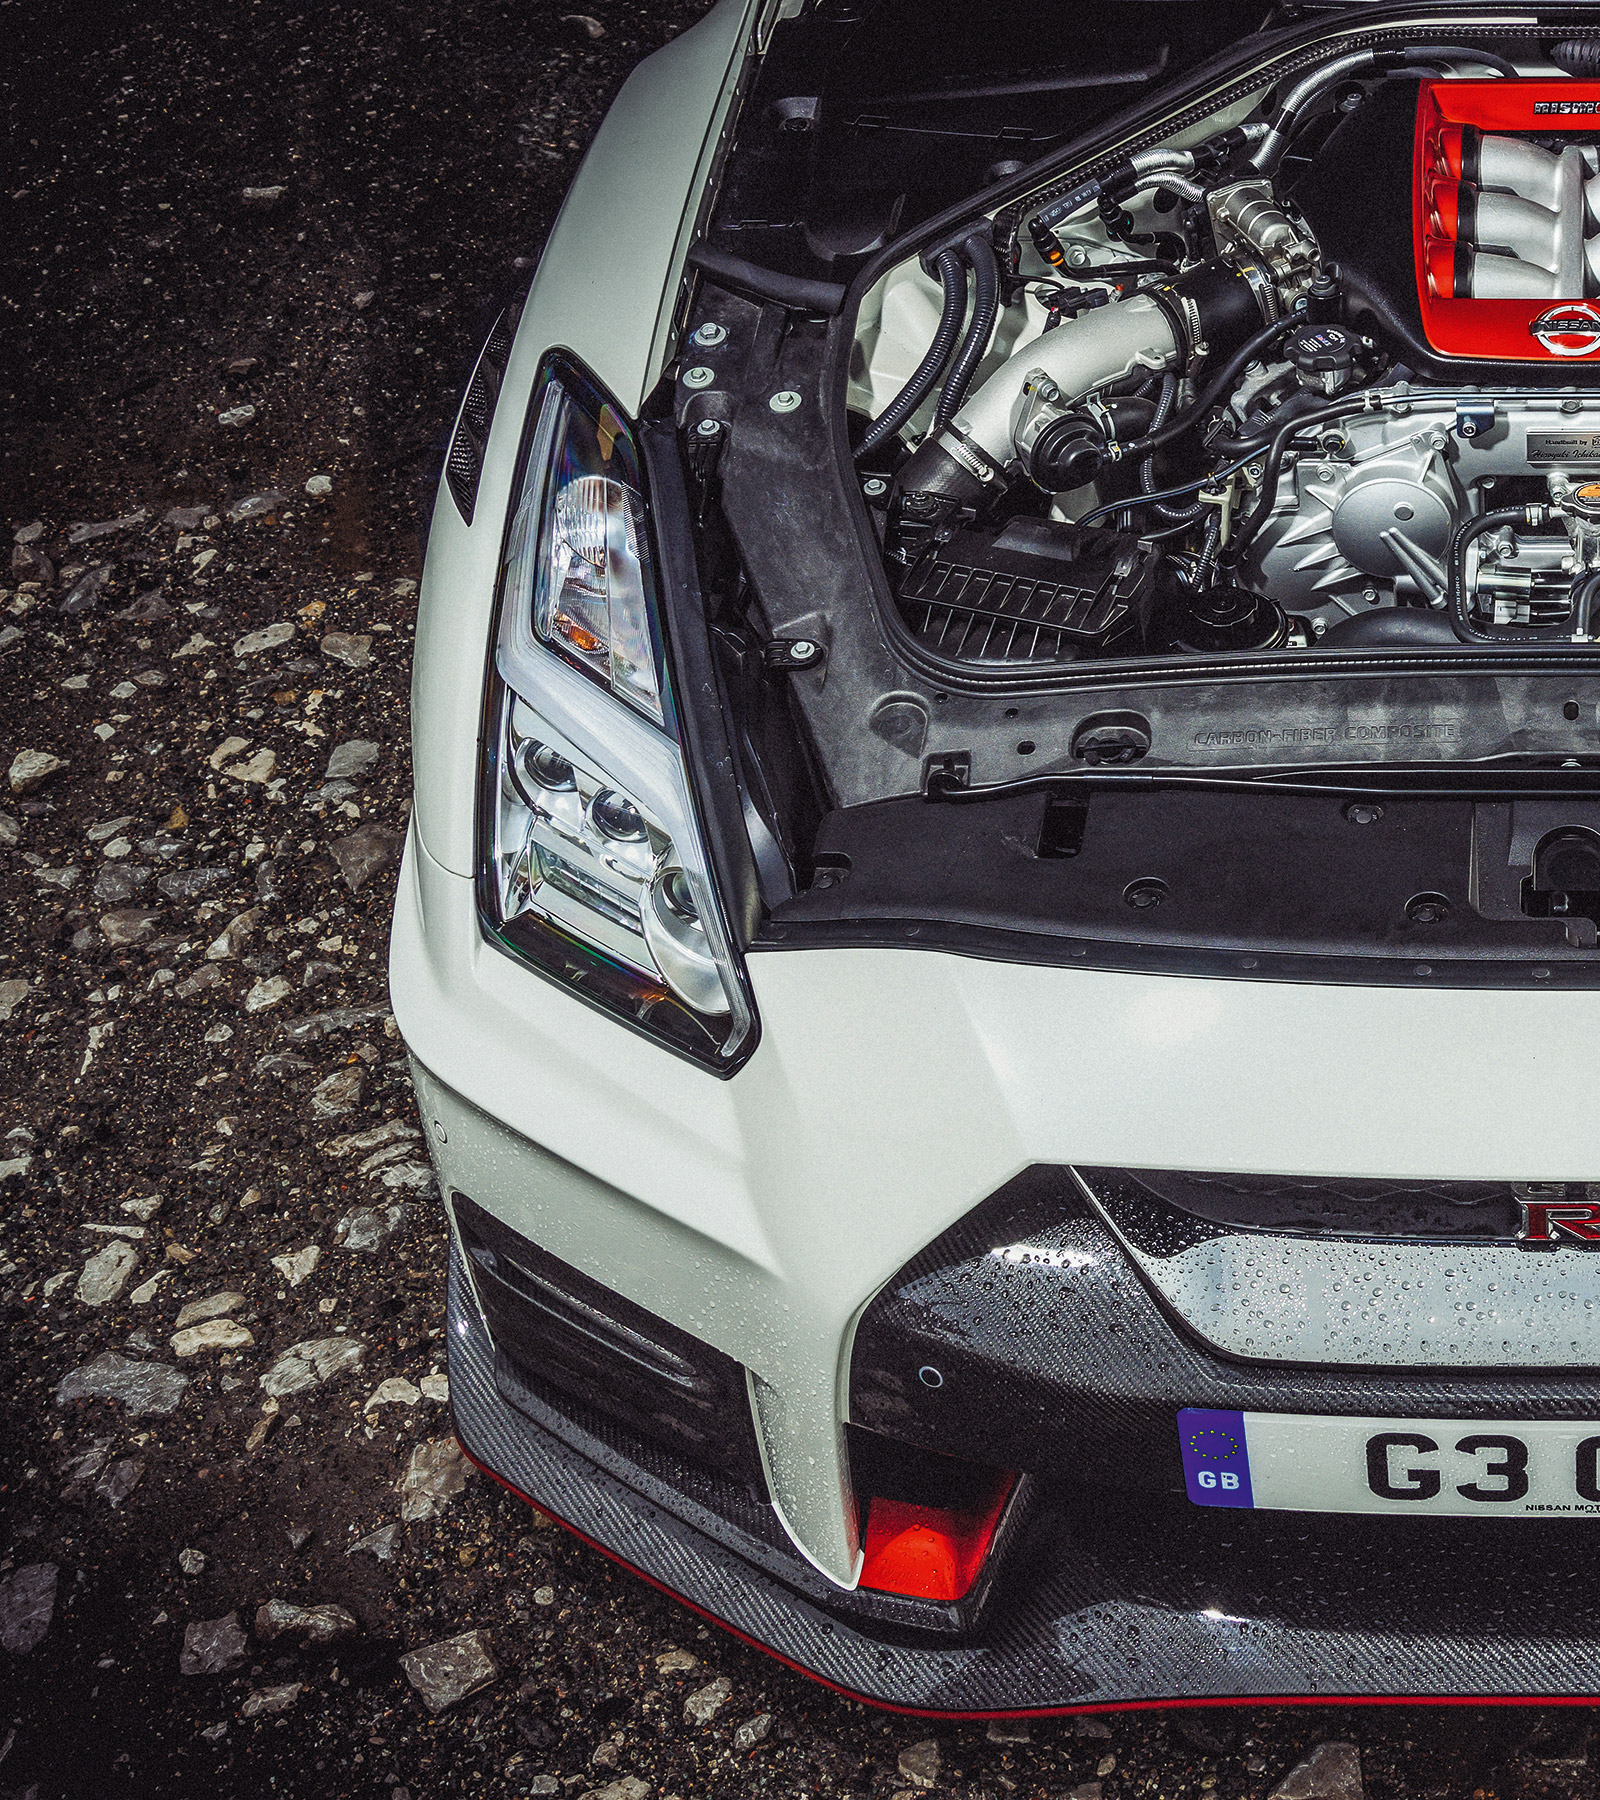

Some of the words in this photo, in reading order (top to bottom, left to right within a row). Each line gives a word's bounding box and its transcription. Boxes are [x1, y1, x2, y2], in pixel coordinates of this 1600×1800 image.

[1194, 727, 1337, 746] CARBON-FIBER
[1344, 723, 1456, 741] COMPOSITE
[1365, 1432, 1529, 1502] G3
[1197, 1470, 1240, 1490] GB
